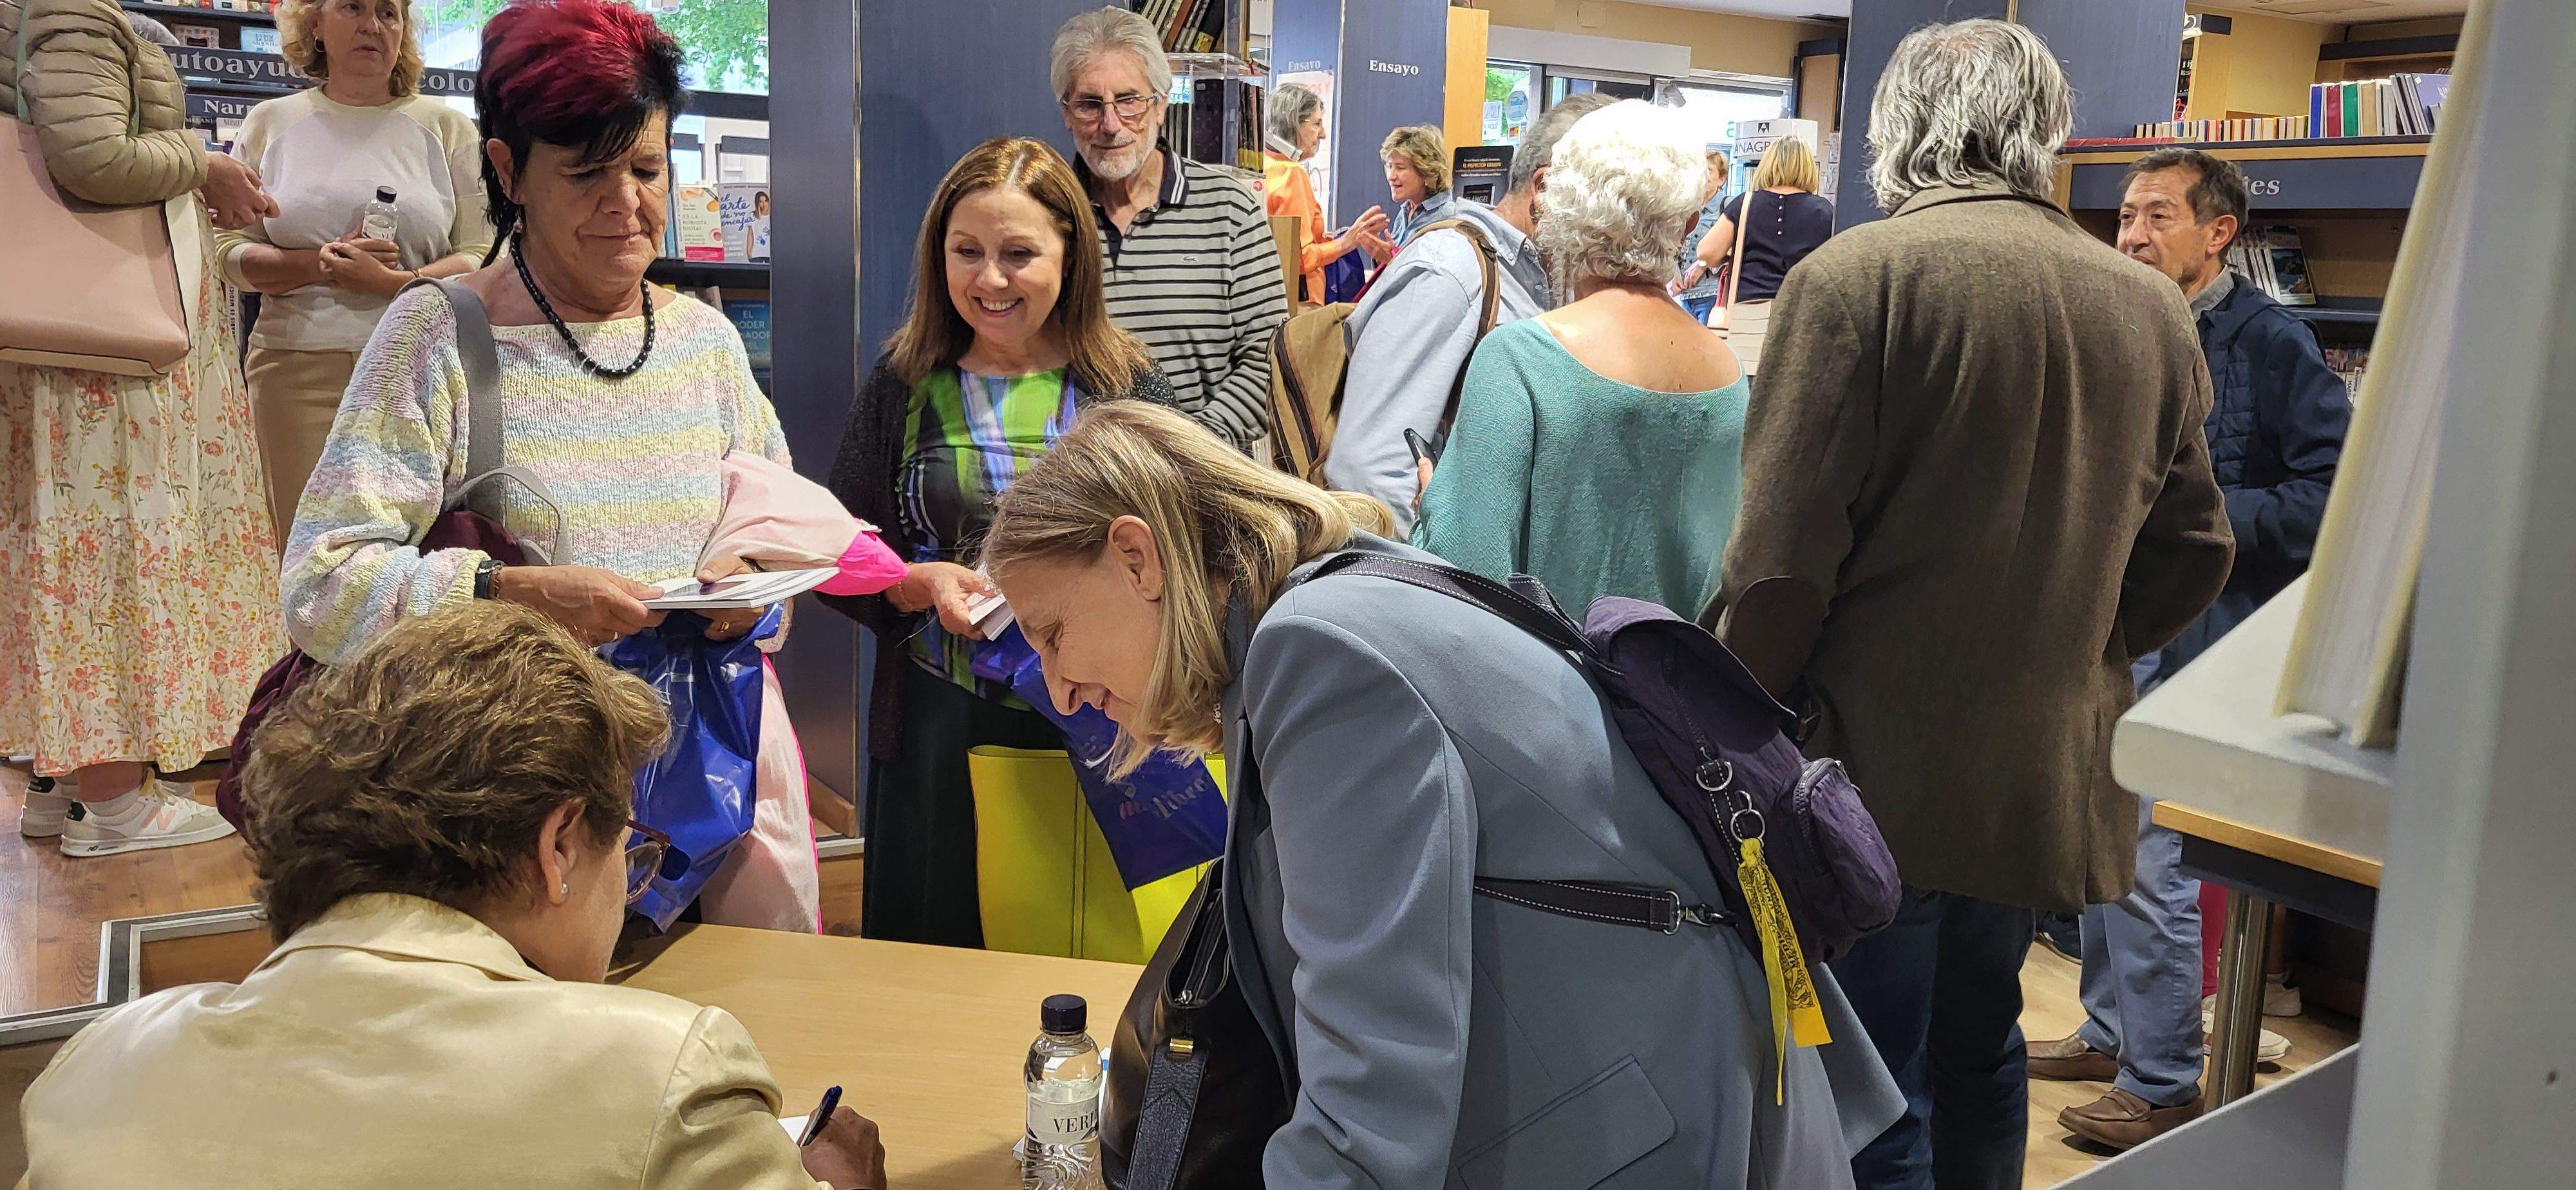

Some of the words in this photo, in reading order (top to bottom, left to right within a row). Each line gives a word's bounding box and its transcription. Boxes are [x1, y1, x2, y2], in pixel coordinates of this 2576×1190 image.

[1289, 61, 1320, 71] Ensayo
[1369, 60, 1419, 76] Ensayo
[720, 196, 751, 210] arte
[721, 216, 755, 232] encajar
[743, 310, 753, 319] EL
